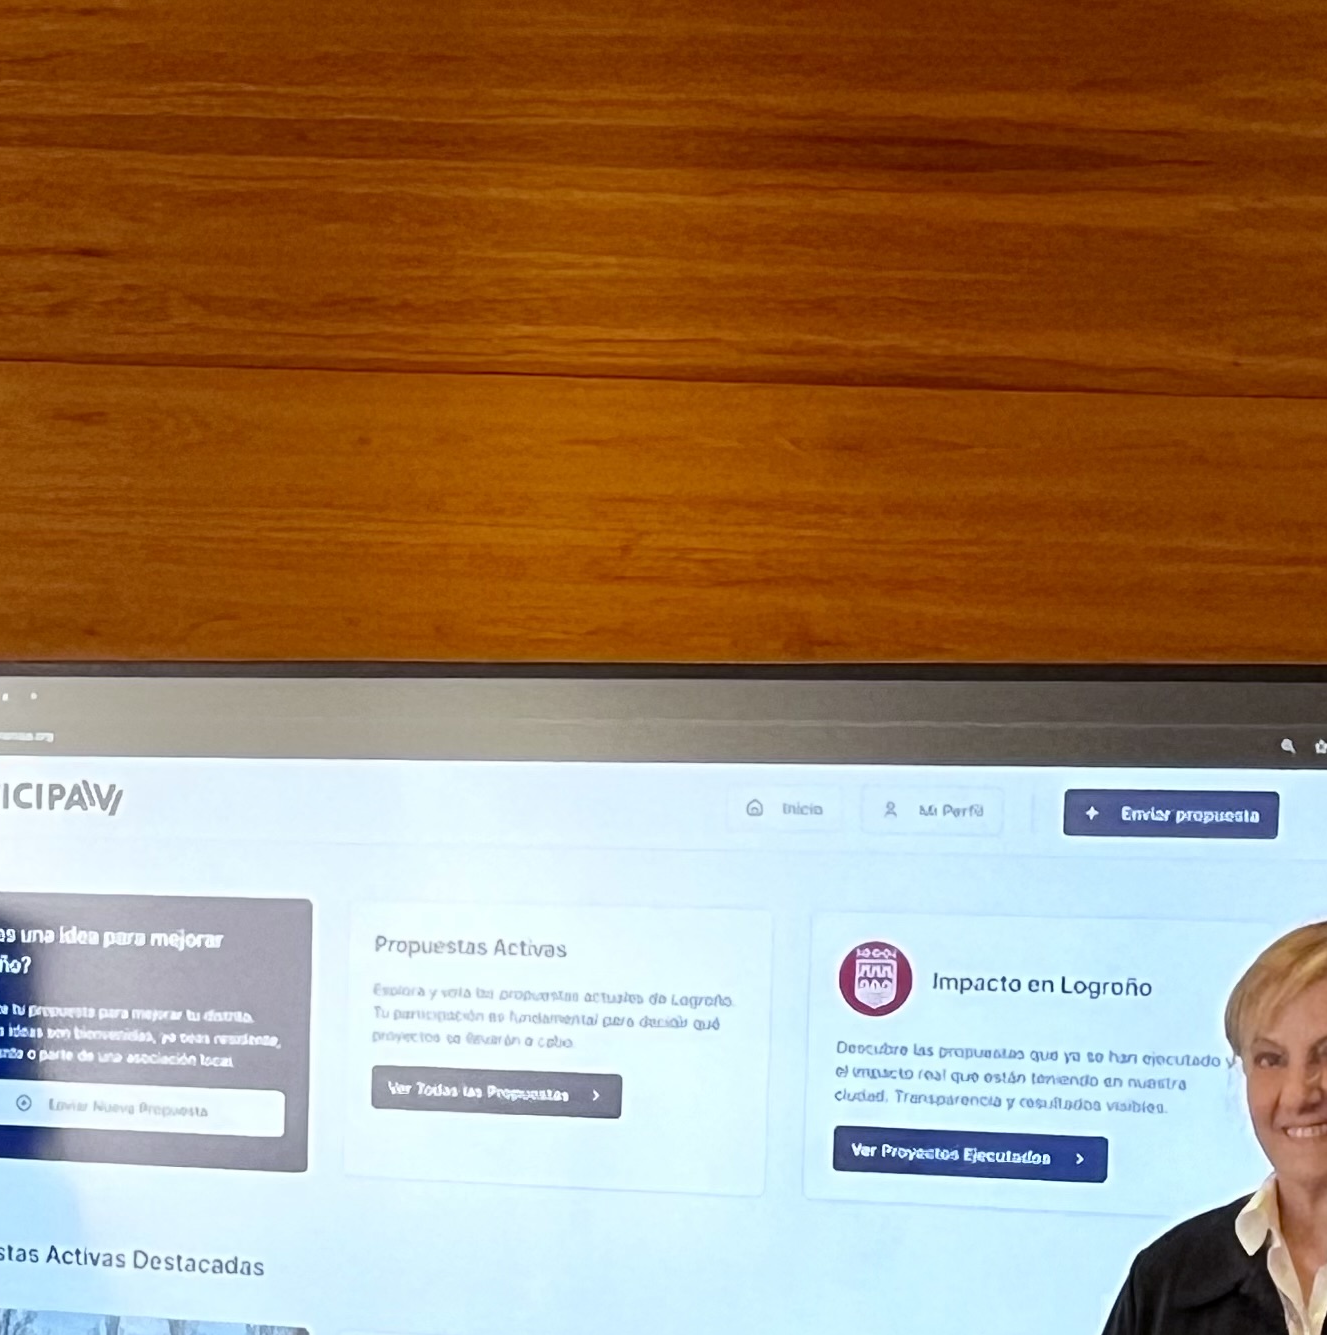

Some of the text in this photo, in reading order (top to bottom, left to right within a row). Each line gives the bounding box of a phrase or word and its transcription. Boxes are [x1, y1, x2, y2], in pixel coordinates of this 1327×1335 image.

[782, 801, 824, 816] Inicio
[1121, 806, 1261, 825] Enviar propuesta
[21, 929, 53, 944] una
[59, 926, 99, 945] idea
[103, 930, 146, 948] para
[150, 930, 224, 951] mejorar
[374, 935, 568, 958] Propuestas Activas
[932, 972, 1153, 999] Impacto en Logroño
[388, 1080, 412, 1095] Ver
[416, 1082, 459, 1098] Todas
[487, 1085, 570, 1103] Propuestas
[851, 1142, 1052, 1166] Ver Proyectos Ejecutados
[46, 1246, 126, 1269] Activas
[133, 1250, 265, 1277] Destacadas
